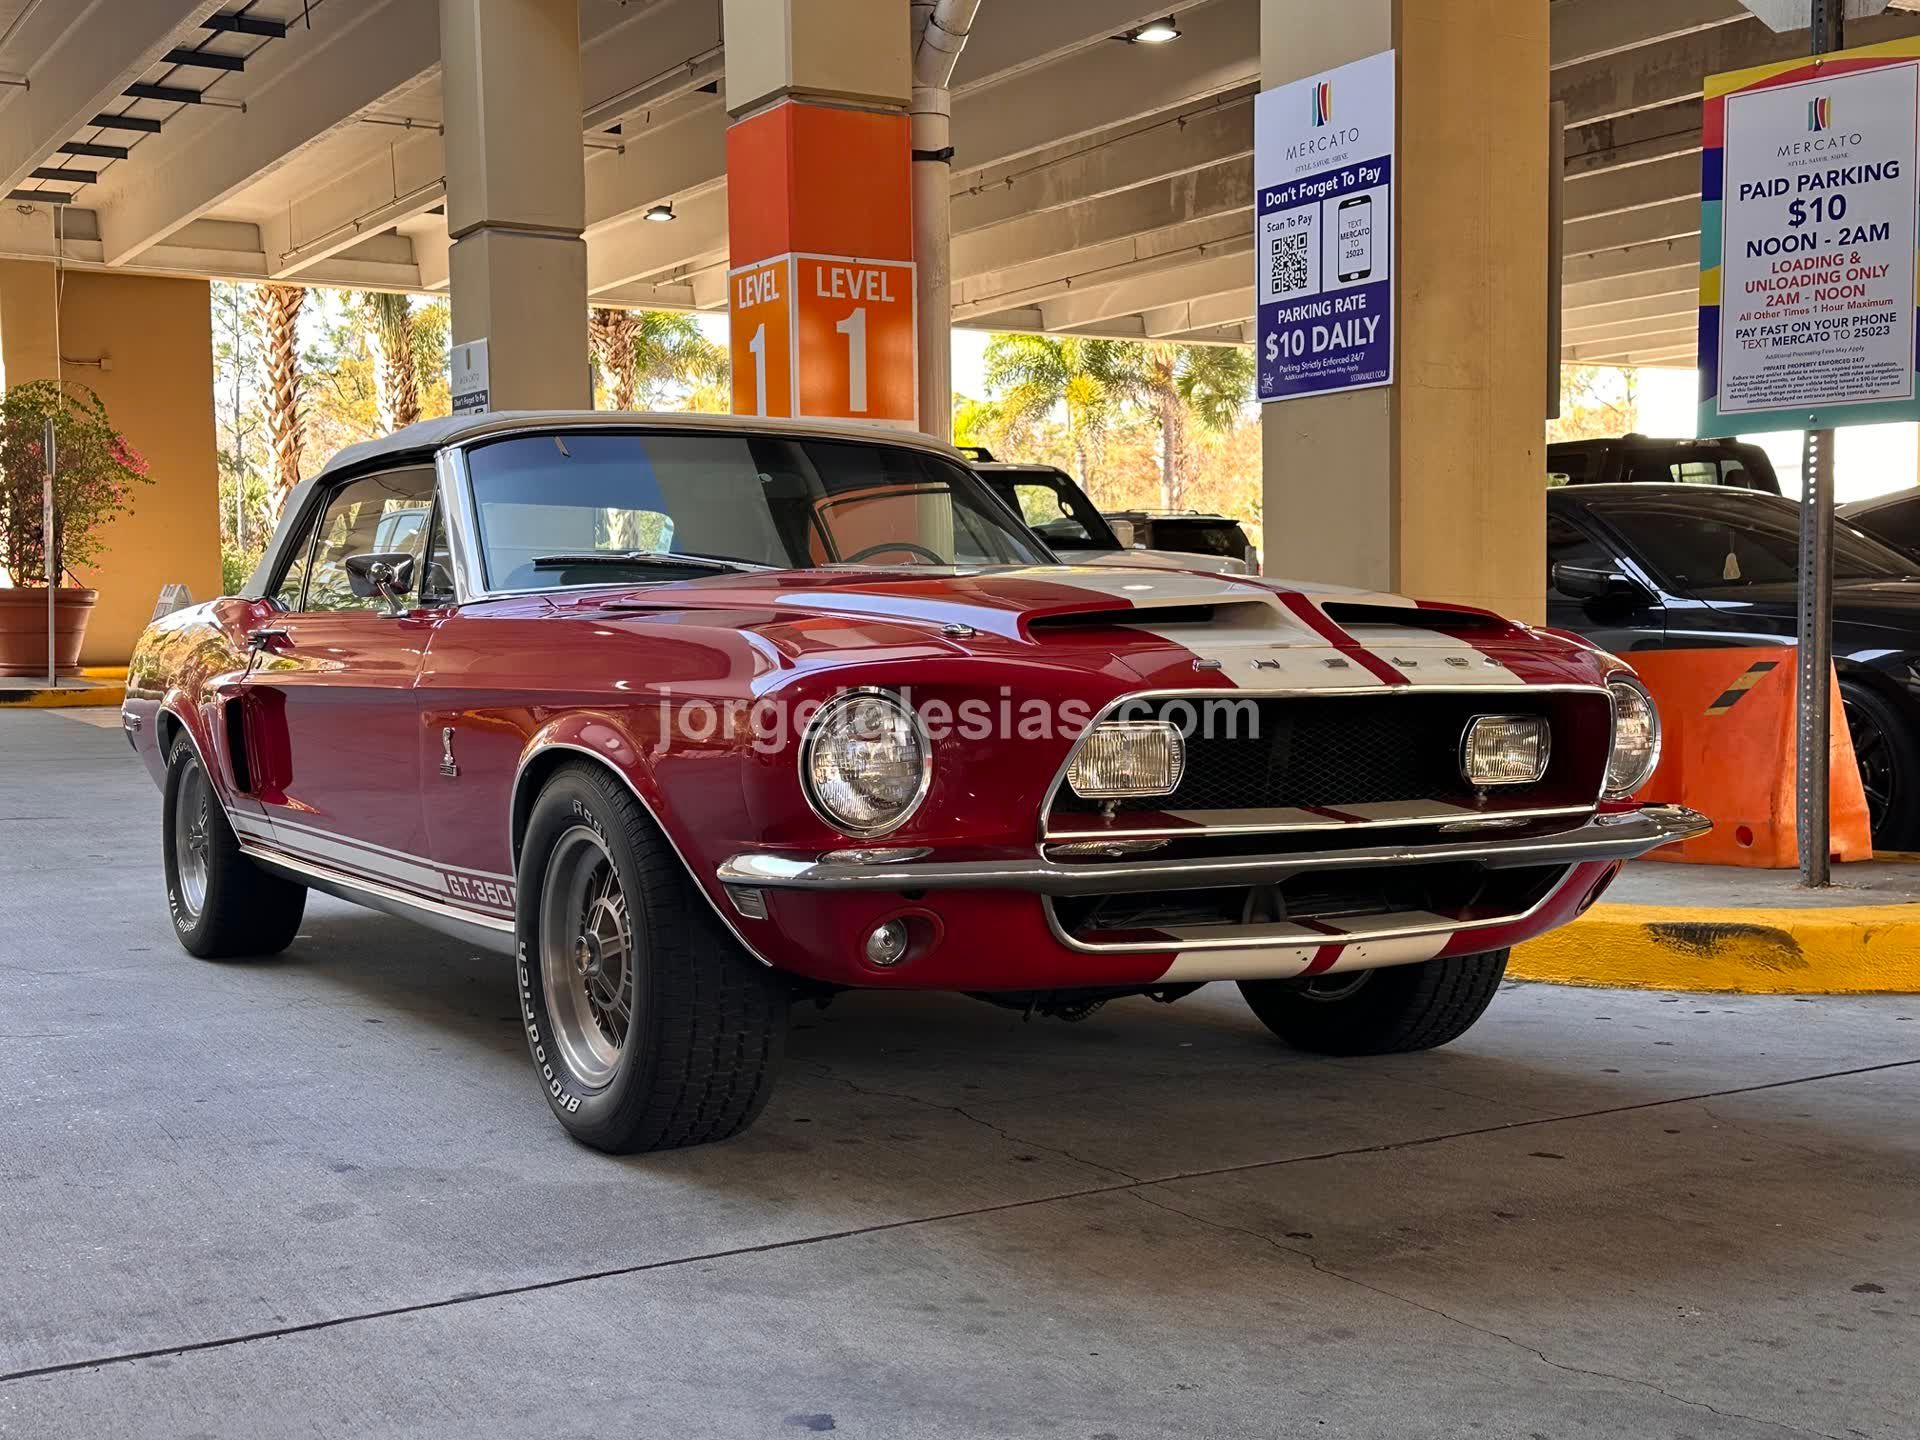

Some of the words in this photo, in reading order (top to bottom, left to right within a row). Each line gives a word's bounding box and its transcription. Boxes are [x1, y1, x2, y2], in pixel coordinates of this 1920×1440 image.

[1286, 128, 1360, 160] MERCATO
[1777, 133, 1862, 157] MERCATO
[1266, 186, 1296, 207] Don't
[1300, 176, 1338, 198] Forget
[1341, 171, 1355, 187] To
[1358, 167, 1381, 184] Pay
[1740, 178, 1790, 201] PAID
[1797, 160, 1900, 193] PARKING
[1267, 221, 1285, 232] Scan
[1286, 218, 1296, 228] To
[1298, 214, 1313, 226] Pay
[1347, 219, 1363, 229] TEXT
[1788, 194, 1847, 229] $10
[1340, 227, 1370, 241] MERCATO
[1350, 239, 1360, 248] TO
[1746, 232, 1817, 258] NOON
[1838, 222, 1890, 246] 2AM
[1346, 248, 1364, 259] 25023
[1772, 253, 1845, 274] LOADING
[1850, 251, 1862, 264] &
[739, 269, 780, 309] LEVEL
[816, 266, 895, 303] LEVEL
[1745, 270, 1841, 293] UNLOADING
[1846, 264, 1890, 281] ONLY
[1278, 300, 1331, 324] PARKING
[1335, 294, 1366, 313] RATE
[1739, 312, 1751, 322] All
[1754, 309, 1780, 320] Other
[1783, 307, 1810, 317] Times
[1813, 305, 1818, 313] 1
[1821, 302, 1844, 312] Hour
[1847, 298, 1894, 310] Maximum
[1766, 292, 1800, 307] 2AM
[1815, 284, 1865, 301] NOON
[1266, 329, 1305, 362] $10
[1312, 314, 1381, 353] DAILY
[1735, 328, 1757, 339] PAY
[1760, 324, 1788, 336] FAST
[1791, 321, 1811, 333] ON
[1814, 317, 1849, 330] YOUR
[1852, 312, 1897, 326] PHONE
[1741, 338, 1769, 350] TEXT
[1772, 332, 1830, 347] MERCATO
[1834, 329, 1851, 341] TO
[1854, 326, 1890, 338] 25023
[749, 323, 767, 417] 1
[836, 307, 868, 412] 1
[1279, 363, 1300, 373] Parking
[447, 873, 513, 908] G.T.350
[518, 941, 582, 1113] BFGoodrich
